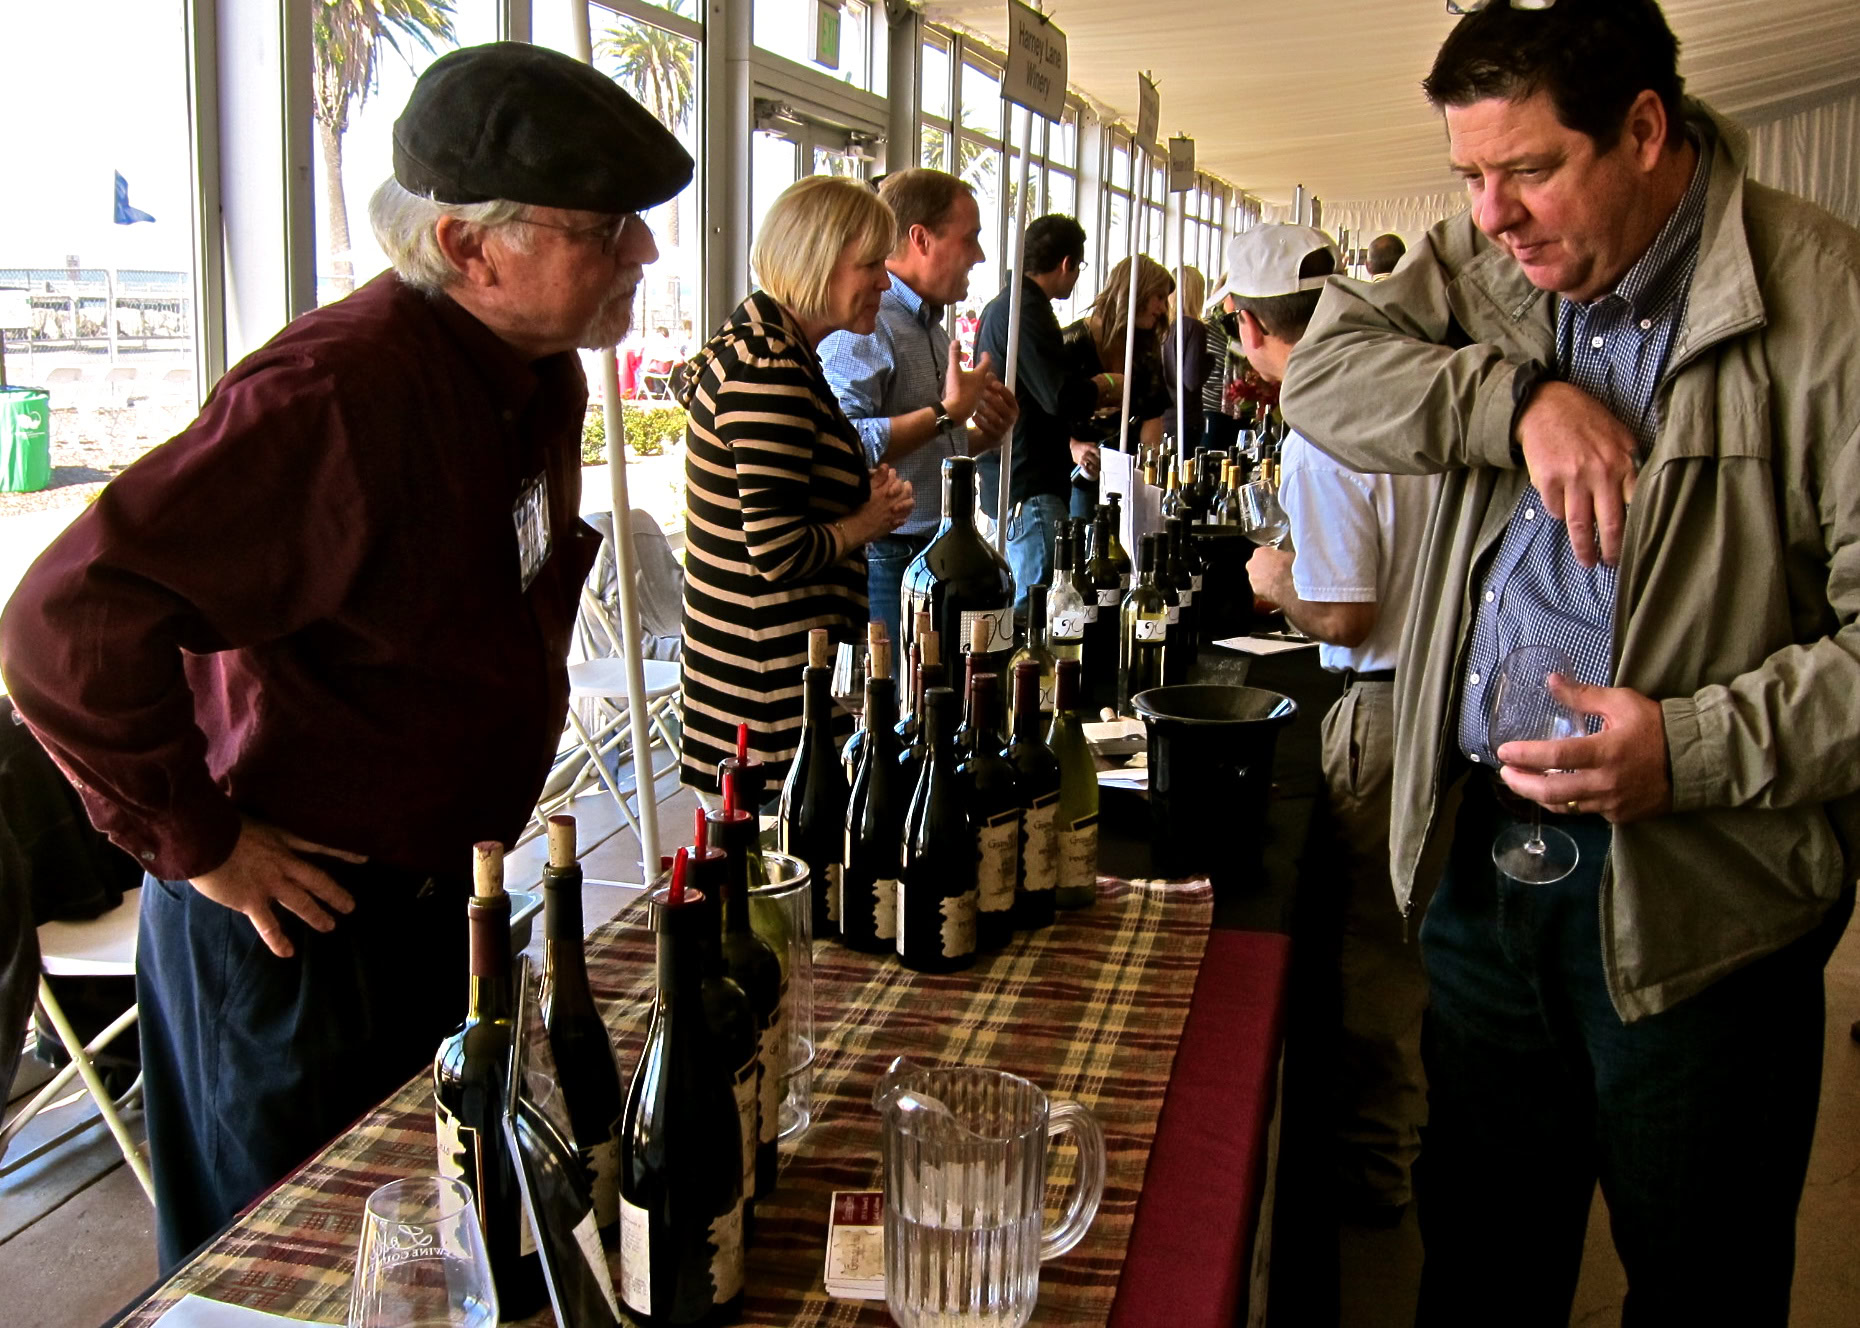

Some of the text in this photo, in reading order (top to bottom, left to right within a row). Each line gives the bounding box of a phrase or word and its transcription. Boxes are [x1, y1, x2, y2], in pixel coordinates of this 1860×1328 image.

[1018, 20, 1062, 70] Harney Lane
[1026, 61, 1051, 102] Winery
